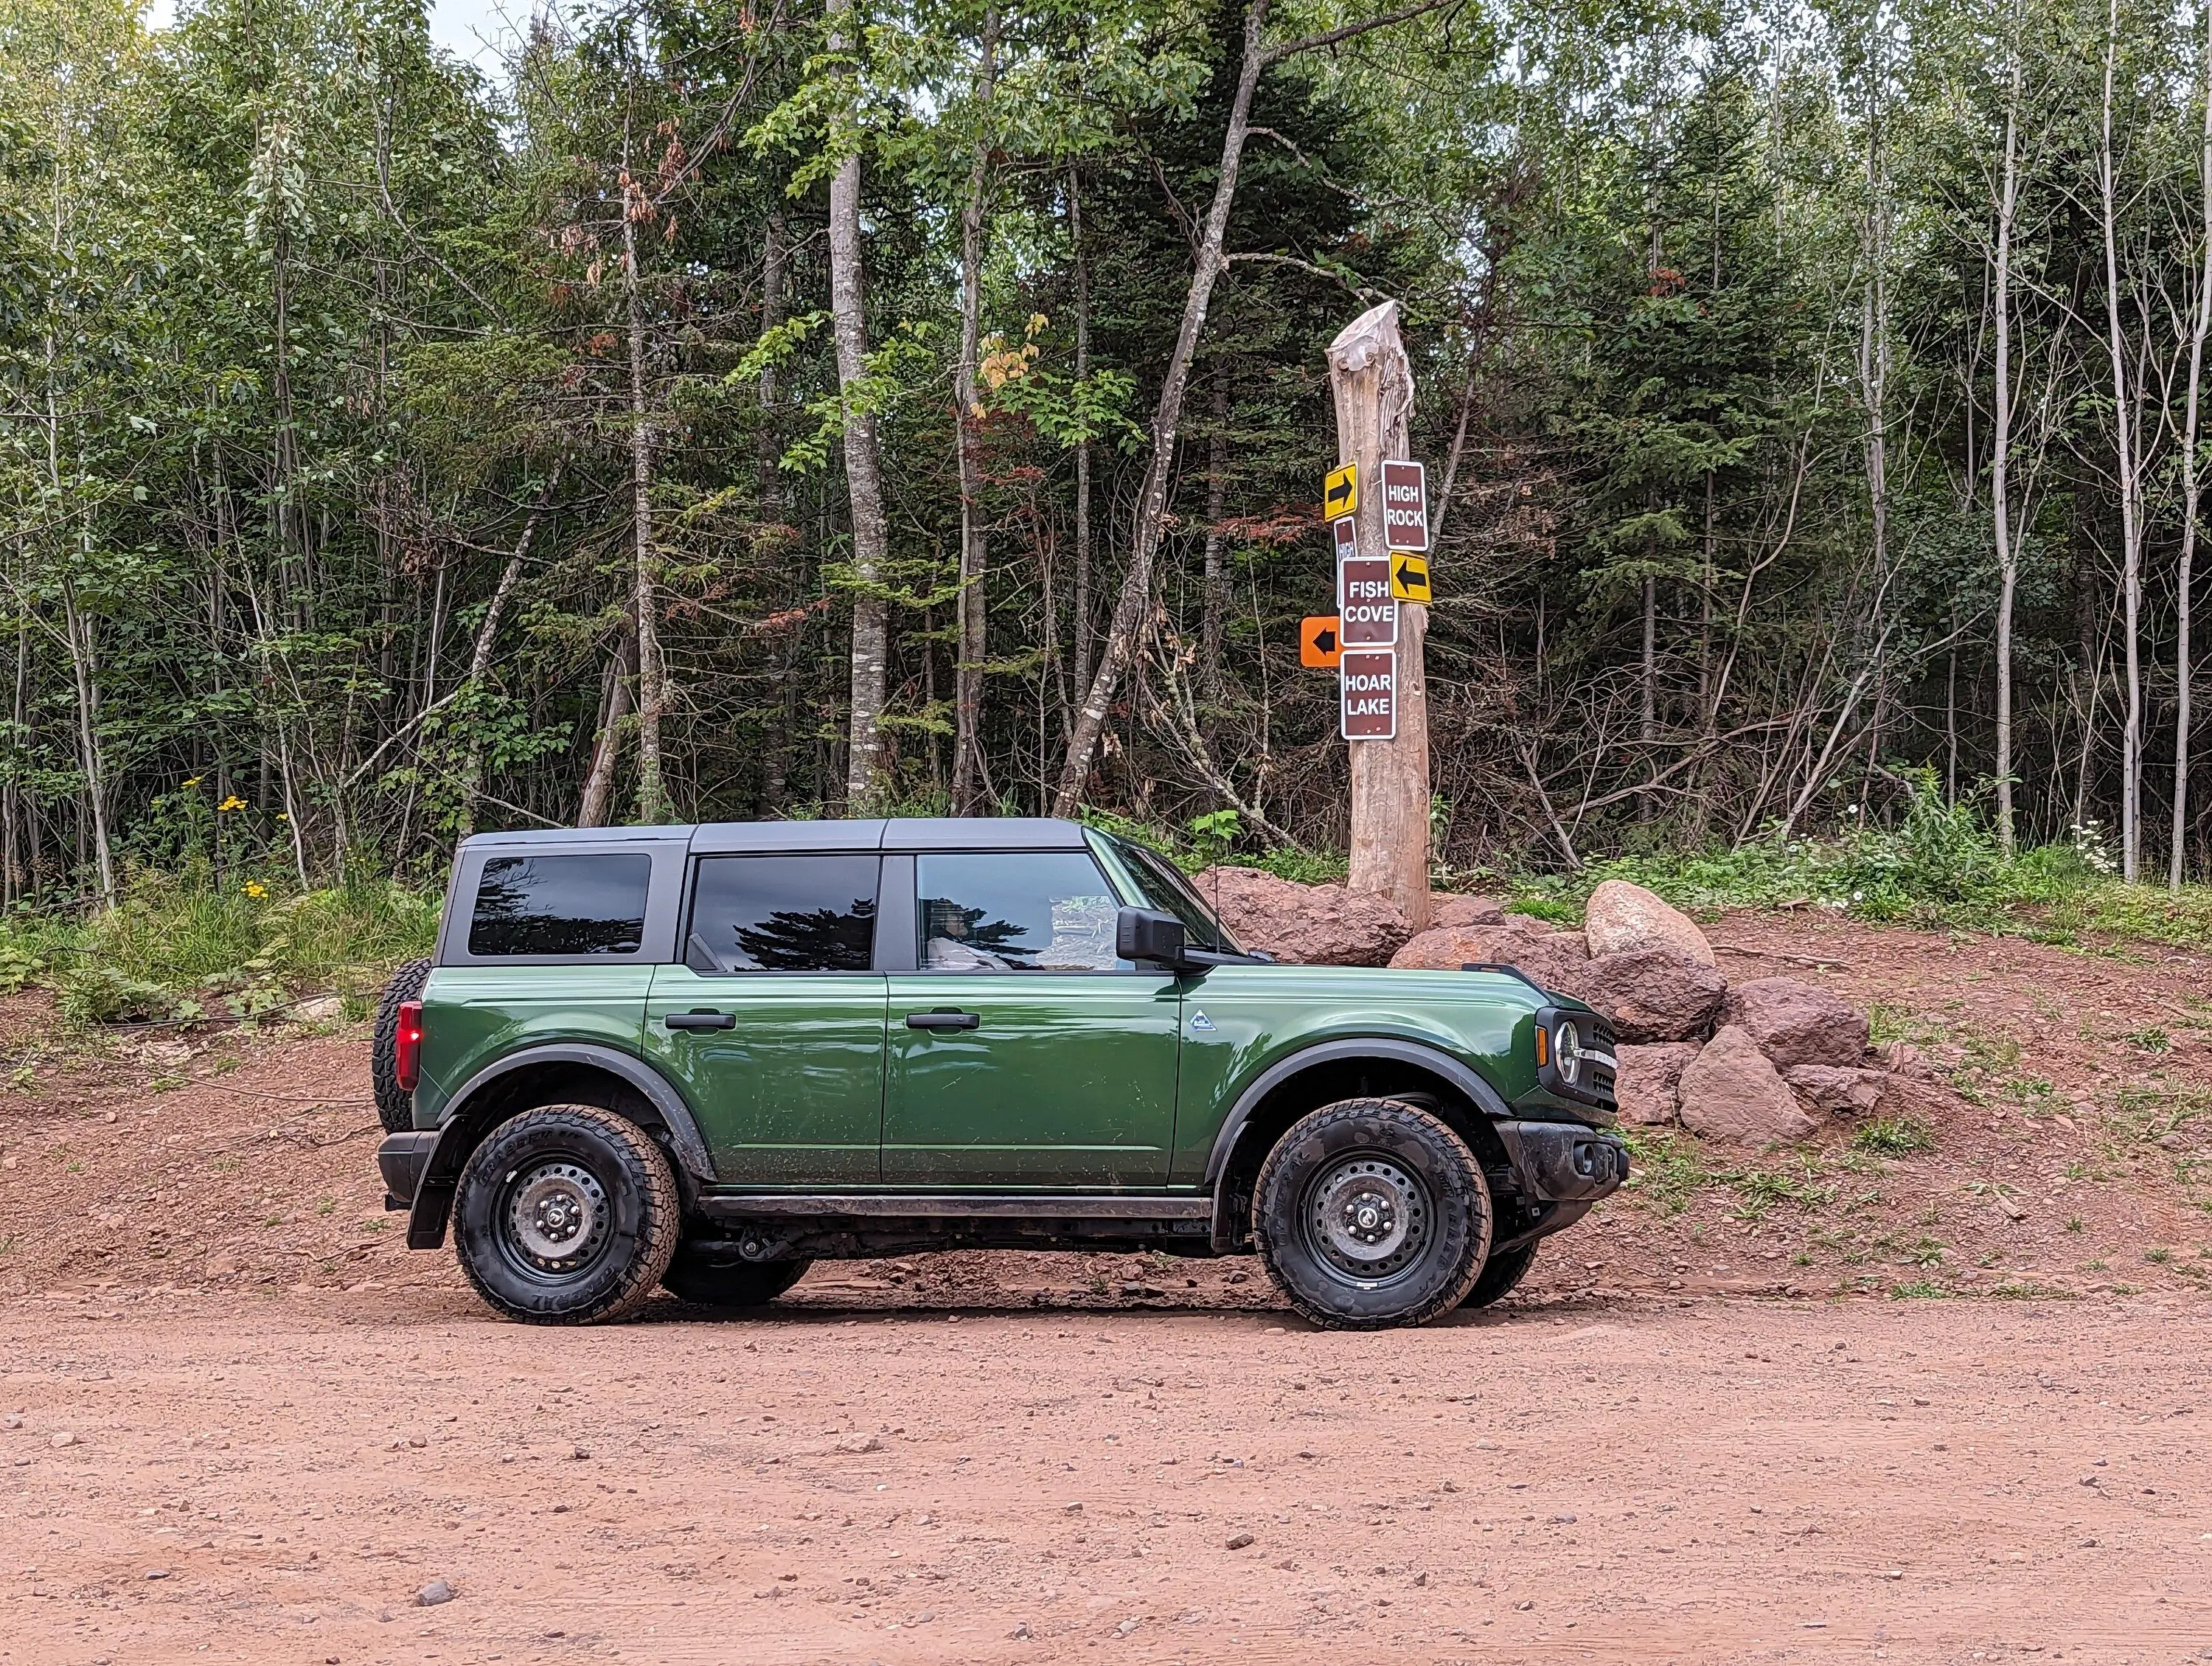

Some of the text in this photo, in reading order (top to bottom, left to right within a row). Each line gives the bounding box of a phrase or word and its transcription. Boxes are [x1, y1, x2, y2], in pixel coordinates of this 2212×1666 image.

[1388, 485, 1419, 502] HIGH
[1387, 509, 1424, 527] ROCK
[1349, 581, 1389, 598] FISH
[1345, 605, 1394, 622] COVE
[1345, 674, 1391, 691] HOAR
[1347, 698, 1390, 715] LAKE
